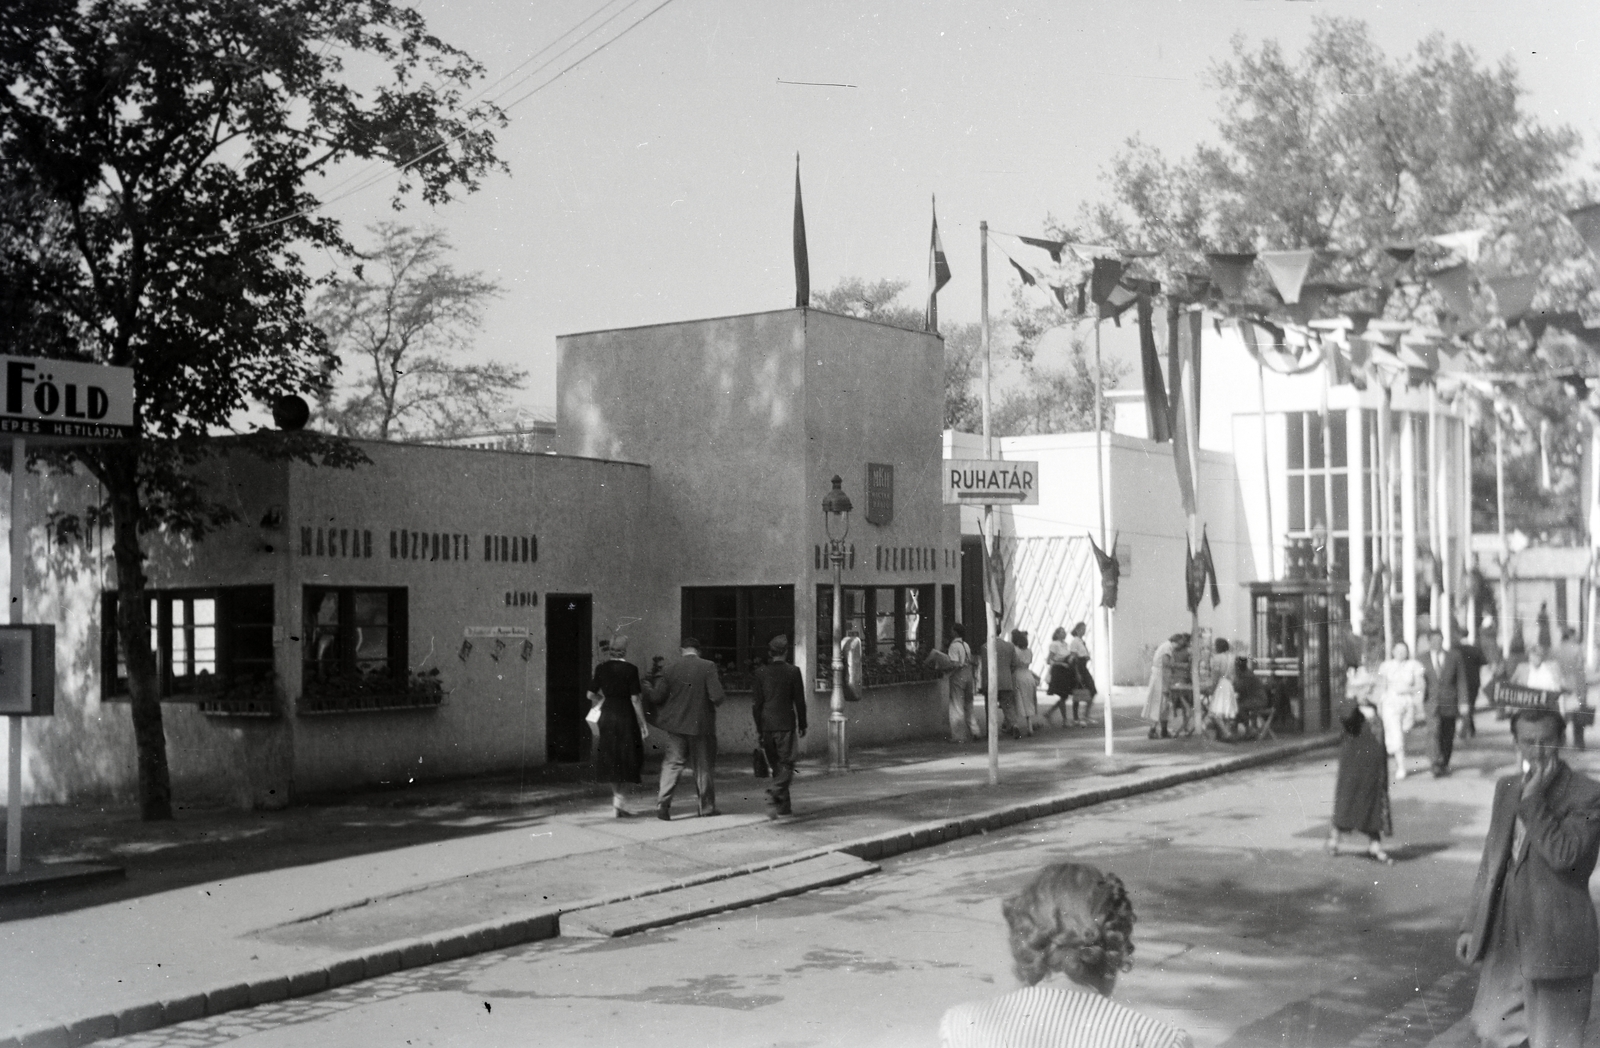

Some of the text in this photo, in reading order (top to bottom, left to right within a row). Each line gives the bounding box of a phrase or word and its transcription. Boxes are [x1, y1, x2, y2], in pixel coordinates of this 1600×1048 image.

[6, 361, 109, 420] FÖLD
[54, 423, 123, 439] HETILAPJA
[951, 464, 1033, 490] RUHATÁR
[301, 526, 372, 558] MAGYAR
